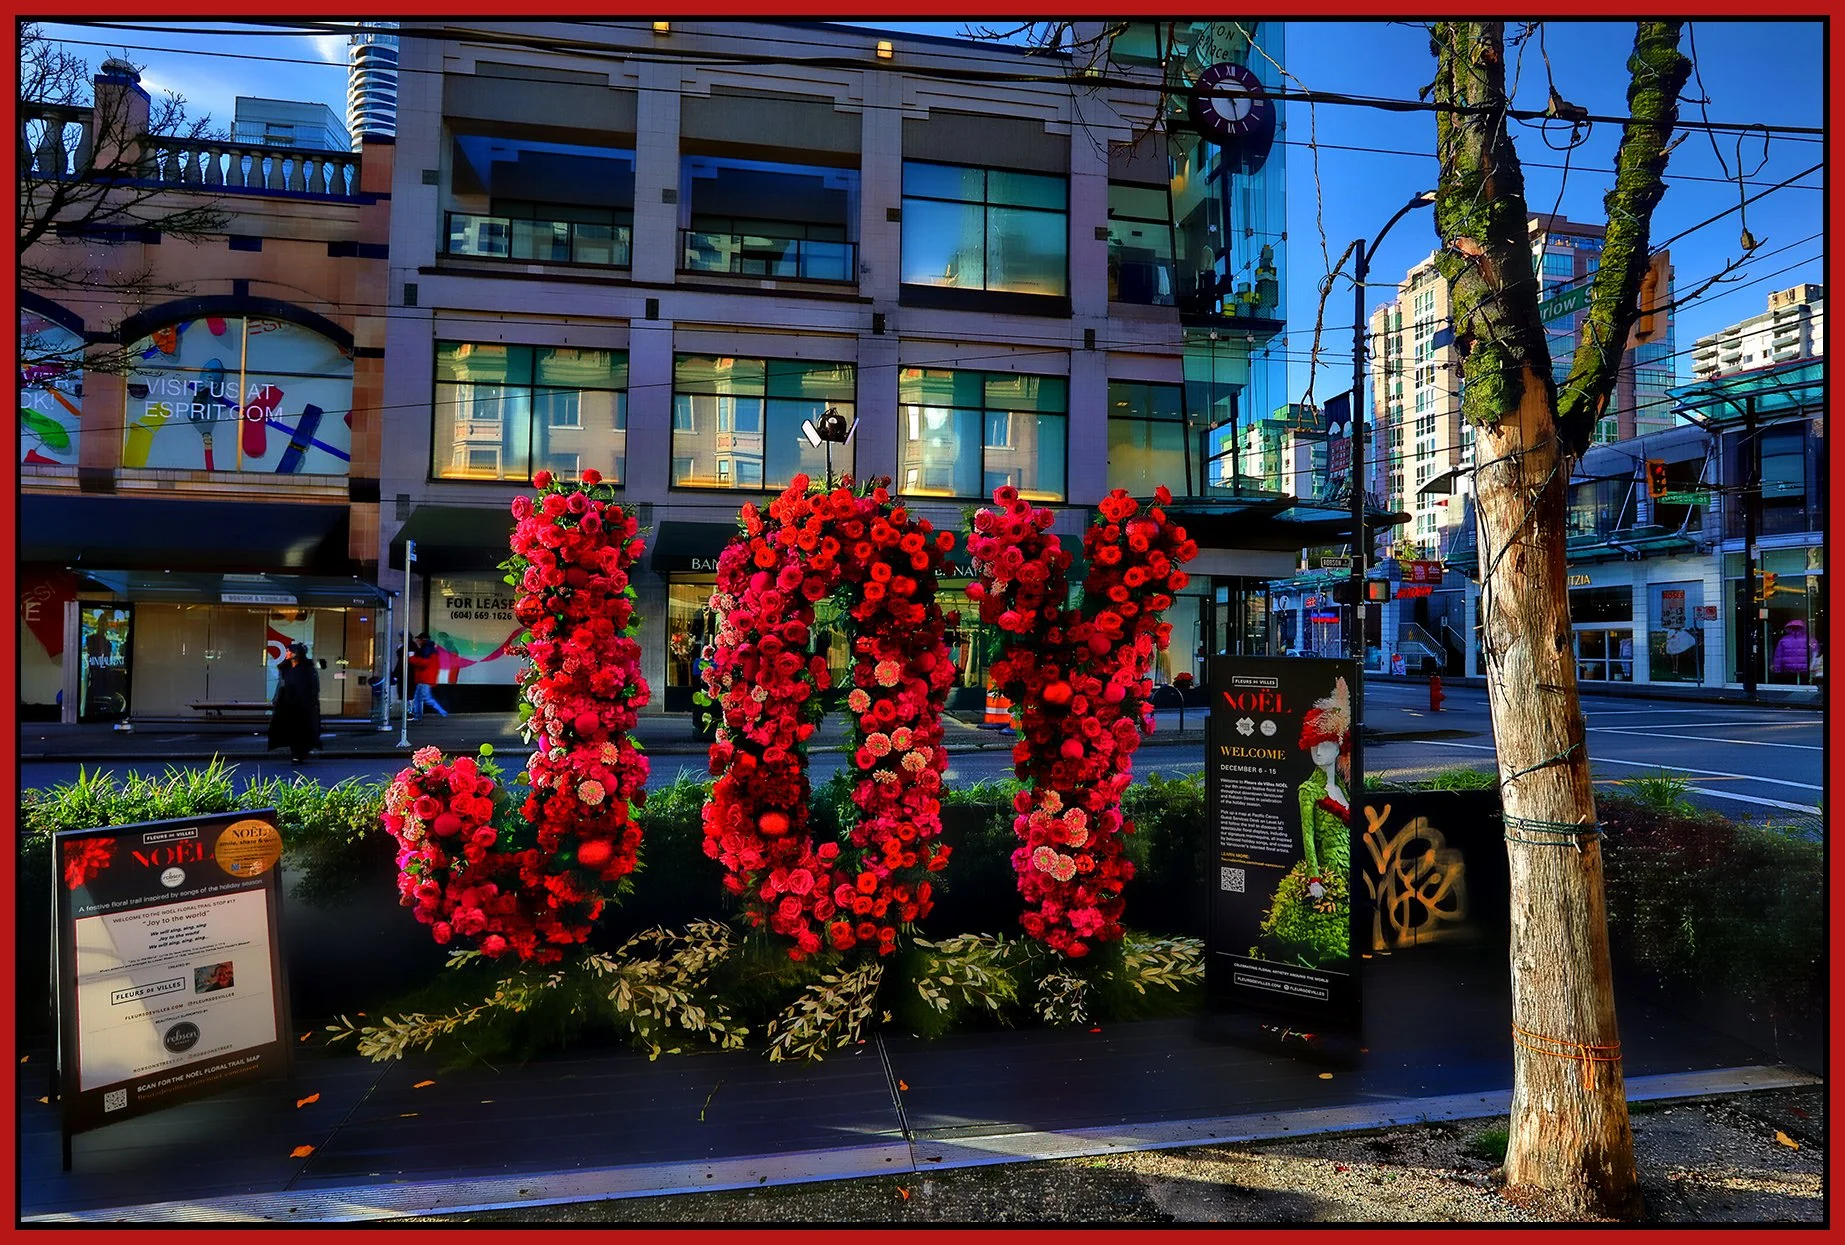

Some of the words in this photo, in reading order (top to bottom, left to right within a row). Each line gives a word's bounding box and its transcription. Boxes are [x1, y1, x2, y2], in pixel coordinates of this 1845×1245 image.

[146, 378, 203, 396] VISIT
[210, 381, 240, 399] US
[247, 383, 275, 400] AT
[144, 400, 283, 422] ESPRIT.COM
[446, 598, 472, 608] FOR
[476, 598, 516, 610] LEASE
[450, 611, 472, 620] (604)
[1223, 688, 1292, 714] NOËL
[1220, 746, 1286, 760] WELCOME
[1220, 764, 1257, 773] DECEMBER
[232, 826, 267, 838] NOËL
[131, 839, 214, 868] NOËL
[144, 893, 169, 902] inspired
[116, 990, 144, 1000] FLEURS
[157, 982, 181, 991] VILLES
[166, 1026, 197, 1044] robson
[137, 1082, 156, 1092] SCAN
[158, 1079, 171, 1087] FOR
[172, 1075, 184, 1083] THE
[204, 1064, 227, 1074] FLORAL
[227, 1059, 245, 1068] TRAIL
